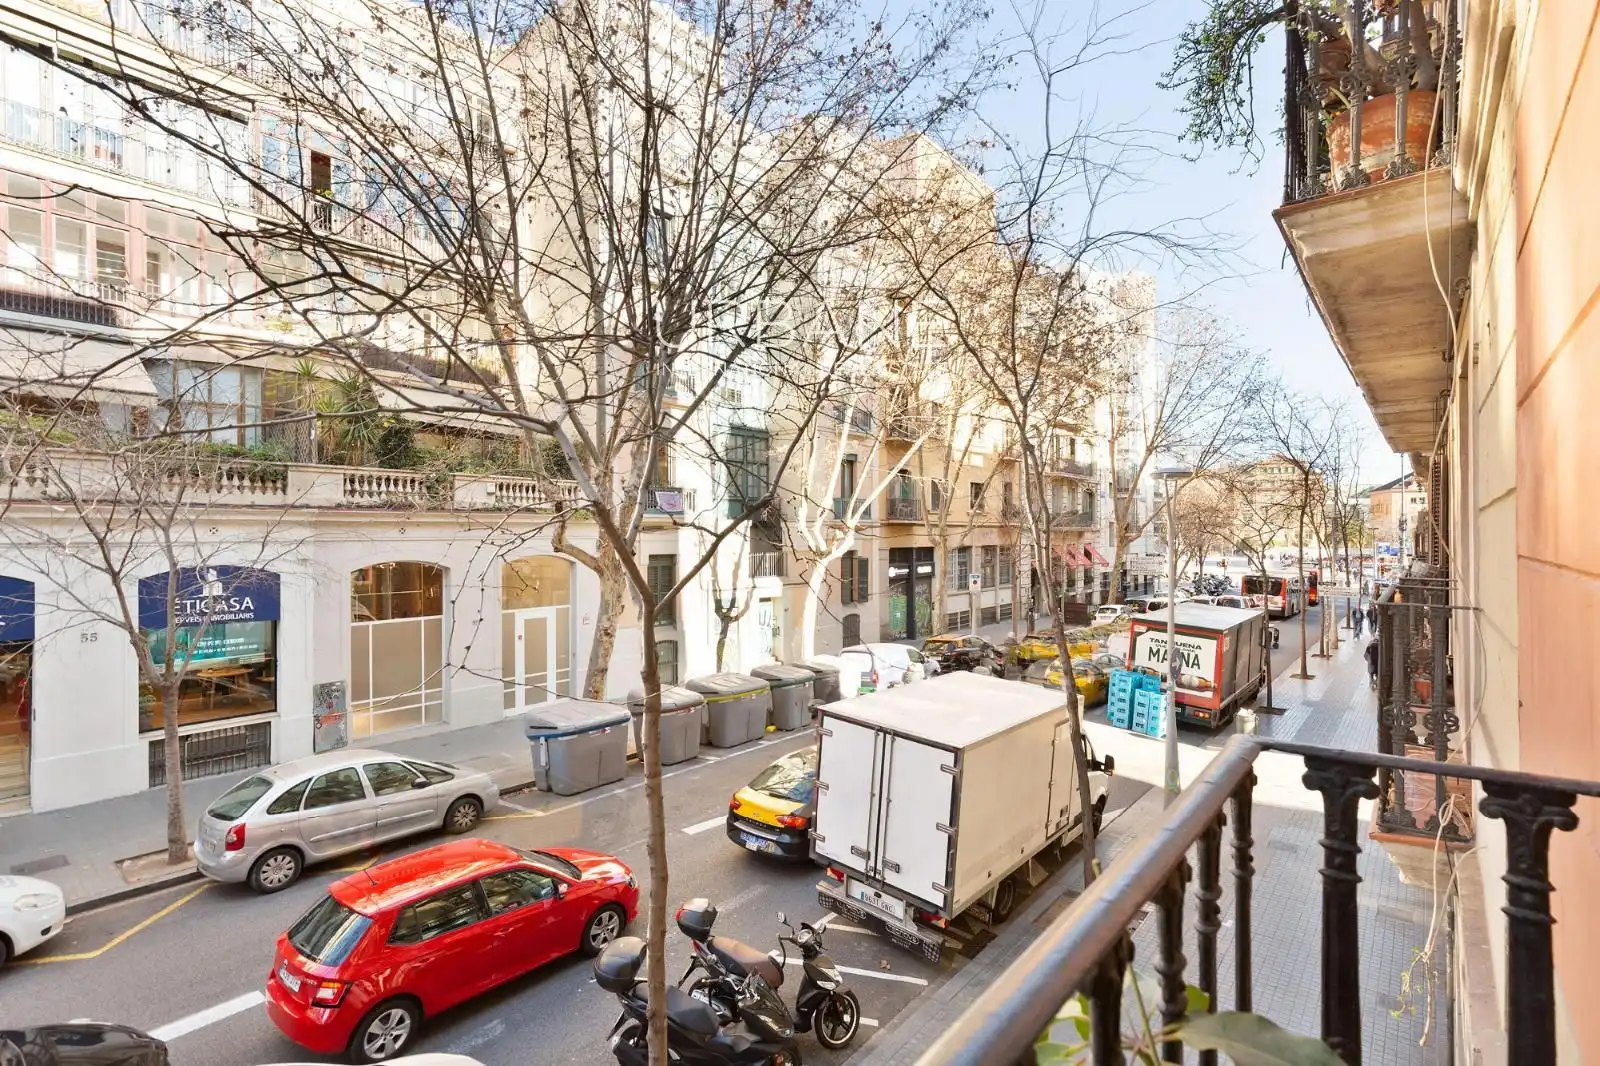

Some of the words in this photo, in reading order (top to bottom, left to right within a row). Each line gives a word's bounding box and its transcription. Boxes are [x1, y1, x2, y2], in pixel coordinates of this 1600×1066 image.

[80, 632, 98, 643] 55
[1149, 637, 1168, 645] TAN
[1174, 641, 1202, 650] UENA
[1148, 647, 1201, 669] MANA
